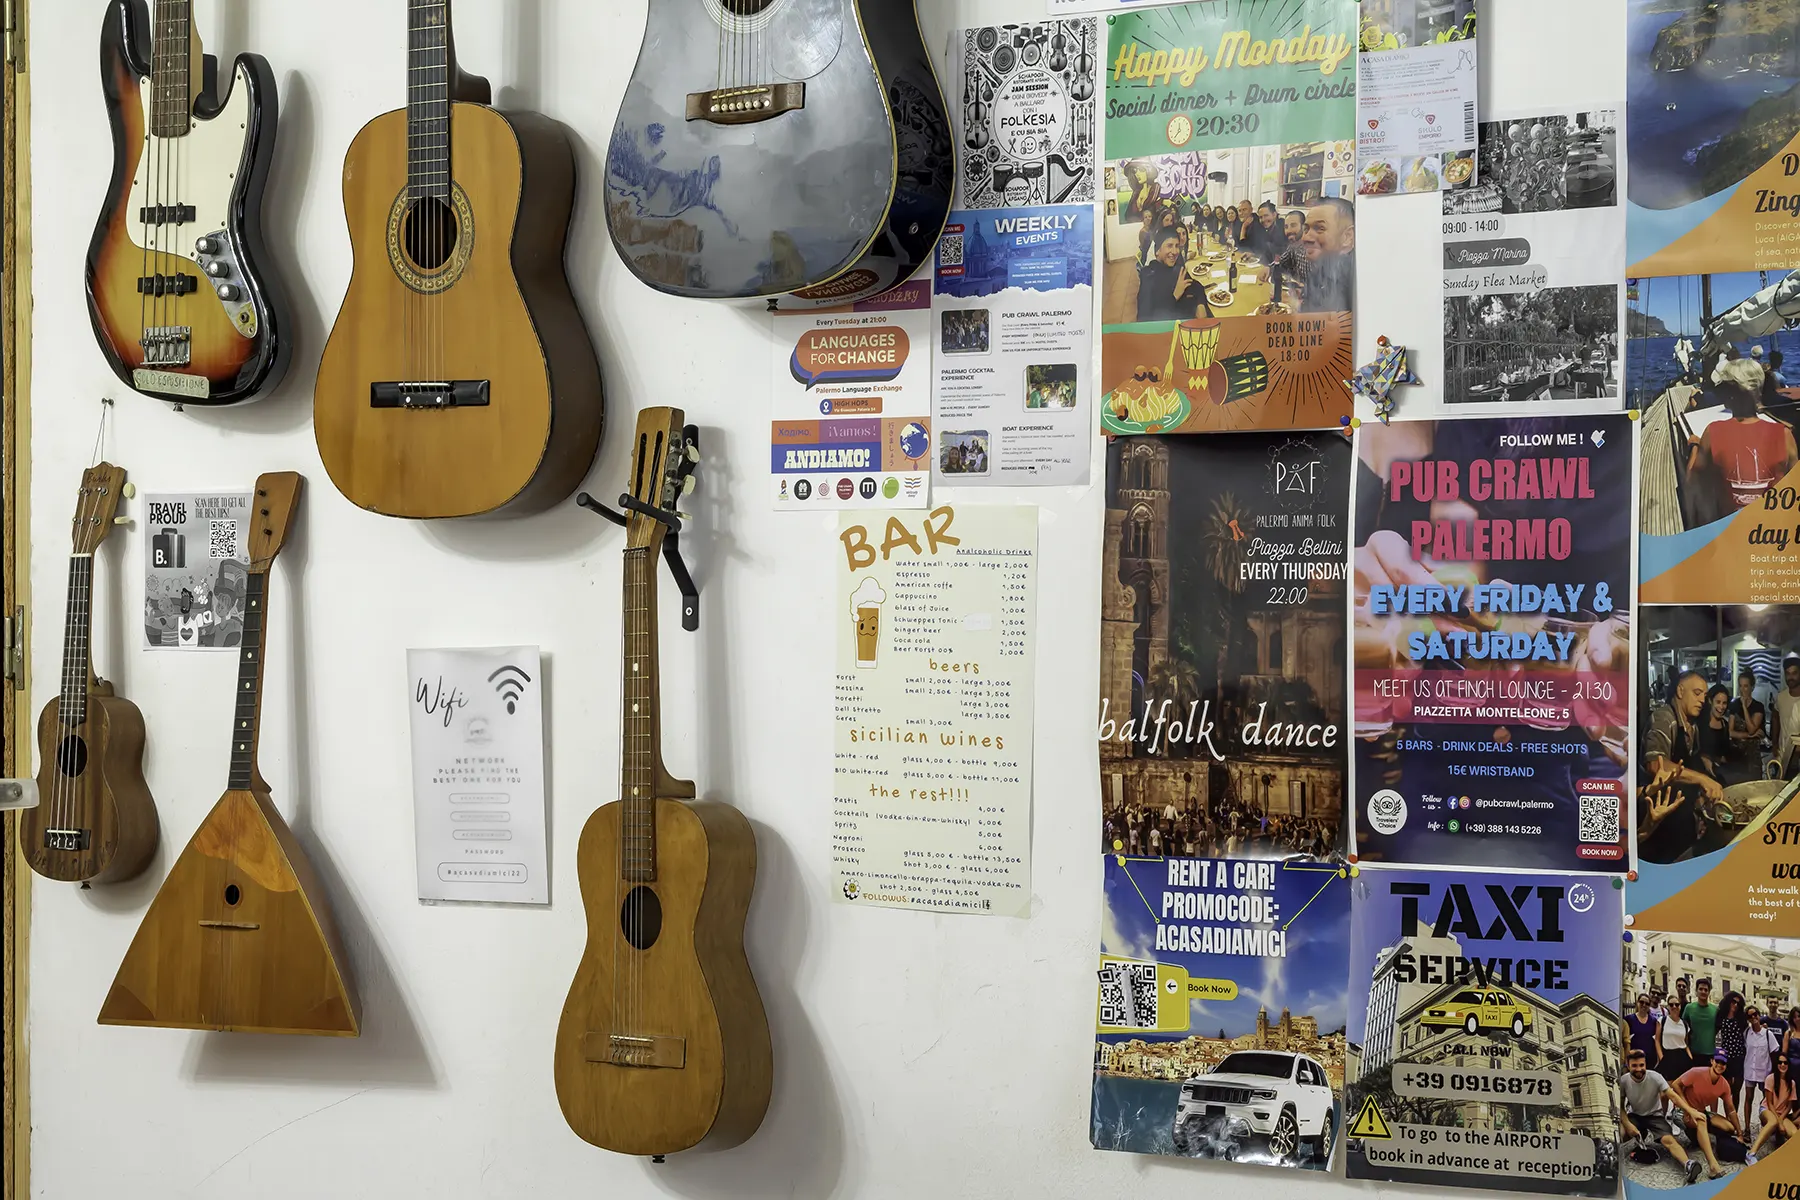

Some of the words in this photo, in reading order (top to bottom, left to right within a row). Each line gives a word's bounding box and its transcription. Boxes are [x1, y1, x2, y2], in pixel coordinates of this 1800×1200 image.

[1113, 42, 1208, 88] Happy
[1213, 24, 1352, 76] Monday
[1025, 84, 1049, 92] SESSION
[1105, 94, 1157, 120] Social
[1160, 90, 1218, 113] dinner
[1244, 83, 1299, 106] Drum
[1304, 77, 1356, 99] circle
[1001, 113, 1056, 128] FOLKESIA
[1196, 113, 1260, 138] 20:30
[994, 214, 1078, 234] WEEKLY
[1442, 222, 1467, 234] 09:00
[1475, 220, 1498, 232] 14:00
[1756, 222, 1790, 231] Discover
[1016, 232, 1058, 246] EVENTS
[1755, 235, 1774, 244] Luca
[1458, 250, 1489, 264] Piazza
[1491, 248, 1528, 261] Marina
[1443, 275, 1480, 291] Sunday
[1484, 274, 1505, 288] Flea
[1509, 271, 1546, 288] Market
[834, 318, 860, 326] Tuesday
[1266, 321, 1293, 334] BOOK
[1297, 319, 1327, 332] NOW!
[810, 334, 896, 350] LANGUAGES
[1268, 335, 1295, 348] DEAD
[1299, 334, 1323, 347] LINE
[810, 354, 836, 364] FOR
[838, 350, 896, 364] CHANGE
[1280, 350, 1310, 362] 18:00
[842, 386, 872, 394] Language
[873, 384, 902, 392] Exchange
[1500, 434, 1553, 447] FOLLOW
[1556, 434, 1576, 445] ME
[784, 448, 870, 469] ANDIAMO!
[1390, 460, 1460, 502] PUB
[1468, 457, 1596, 500] CRAWL
[149, 502, 186, 514] TRAVEL
[150, 513, 186, 524] PROUD
[1256, 514, 1288, 528] PALERMO
[1292, 514, 1314, 528] ANIMA
[1317, 514, 1336, 527] FOLK
[840, 506, 960, 572] BAR
[1411, 518, 1572, 561] PALERMO
[1748, 524, 1790, 552] day
[1247, 538, 1295, 560] Piazza
[1298, 537, 1342, 555] Bellini
[978, 562, 1000, 570] large
[1750, 554, 1770, 562] Boat
[1772, 554, 1787, 564] trip
[1240, 562, 1278, 580] EVERY
[1282, 562, 1348, 580] THURSDAY
[1267, 587, 1308, 604] 22:00
[1370, 584, 1464, 614] EVERY
[1474, 583, 1586, 613] FRIDAY
[1592, 582, 1613, 613] &
[1408, 630, 1575, 661] SATURDAY
[929, 658, 980, 674] beers
[1373, 679, 1409, 698] MEET
[1414, 680, 1430, 698] US
[1458, 680, 1494, 698] FINCH
[1499, 680, 1554, 700] LOUNGE
[416, 675, 469, 727] Wifi
[1414, 706, 1472, 717] PIAZZETTA
[1098, 698, 1225, 761] balfolk
[1242, 701, 1338, 748] dance
[850, 726, 928, 744] sicilian
[940, 730, 1004, 750] wines
[1396, 740, 1403, 750] 5
[1406, 740, 1433, 750] BARS
[1443, 741, 1476, 752] DRINK
[1478, 742, 1513, 753] DEALS
[1521, 742, 1548, 754] FREE
[1550, 743, 1588, 754] SHOTS
[1448, 765, 1467, 776] 15€
[1469, 766, 1534, 778] WRISTBAND
[869, 784, 900, 798] the
[910, 788, 970, 802] rest!!!
[1582, 782, 1601, 790] SCAN
[1602, 782, 1614, 791] ME
[1475, 799, 1554, 810] @pubcrawl.palermo
[834, 810, 869, 818] Cocktails
[1465, 823, 1486, 834] (+39)
[1487, 824, 1503, 834] 388
[1504, 824, 1520, 834] 143
[1520, 825, 1542, 835] 5226
[1582, 848, 1600, 856] BOOK
[1600, 849, 1618, 857] NOW
[833, 856, 860, 865] Whisky
[1168, 858, 1210, 887] RENT
[1215, 862, 1228, 888] A
[1233, 862, 1276, 890] CAR!
[1748, 885, 1754, 893] A
[1756, 884, 1776, 894] slow
[1778, 886, 1798, 894] walk
[1162, 891, 1280, 924] PROMOCODE:
[1748, 898, 1762, 906] the
[1765, 898, 1783, 907] best
[1785, 899, 1794, 908] of
[1390, 882, 1564, 942] TAXI
[1749, 910, 1777, 922] ready!
[1155, 924, 1286, 958] ACASADIAMICI
[1392, 943, 1568, 990] SERVICE
[1188, 983, 1209, 992] Book
[1212, 985, 1232, 994] Now
[1444, 1044, 1476, 1056] CALL
[1480, 1045, 1512, 1057] NOW
[1403, 1072, 1444, 1089] +39
[1451, 1074, 1552, 1096] 0916878
[1399, 1126, 1416, 1139] To
[1420, 1130, 1437, 1144] go
[1446, 1130, 1460, 1142] to
[1465, 1130, 1490, 1145] the
[1494, 1133, 1561, 1150] AIRPORT
[1369, 1147, 1406, 1162] book
[1410, 1150, 1423, 1163] in
[1428, 1150, 1490, 1169] advance
[1494, 1158, 1510, 1170] at
[1518, 1160, 1597, 1178] reception!
